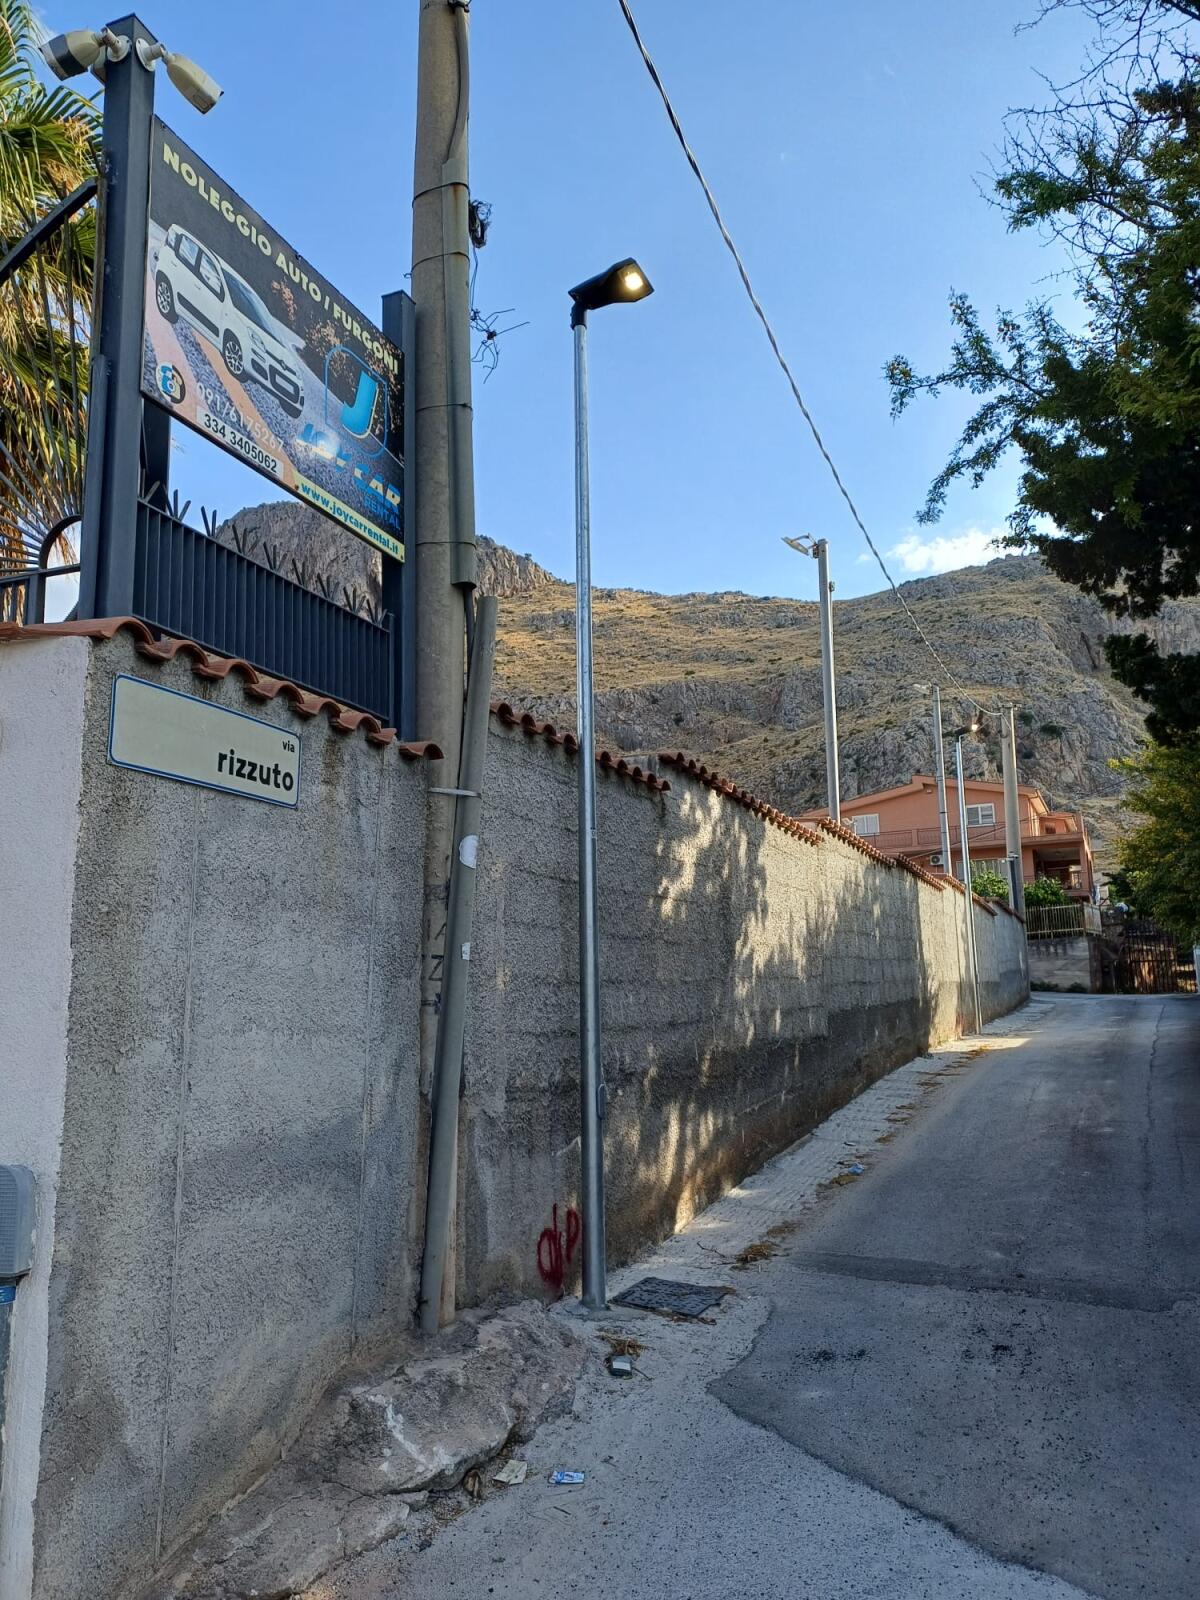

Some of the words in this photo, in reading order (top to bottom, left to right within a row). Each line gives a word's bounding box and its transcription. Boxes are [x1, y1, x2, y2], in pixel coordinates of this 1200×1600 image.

[163, 142, 272, 256] NOLEGGIO
[275, 252, 321, 302] AUTO
[333, 302, 398, 375] FURGONI
[204, 413, 226, 438] 334
[230, 431, 277, 473] 3405062
[301, 482, 399, 555] www.joycarrental.it
[217, 749, 294, 791] rizzuto
[282, 740, 295, 753] via
